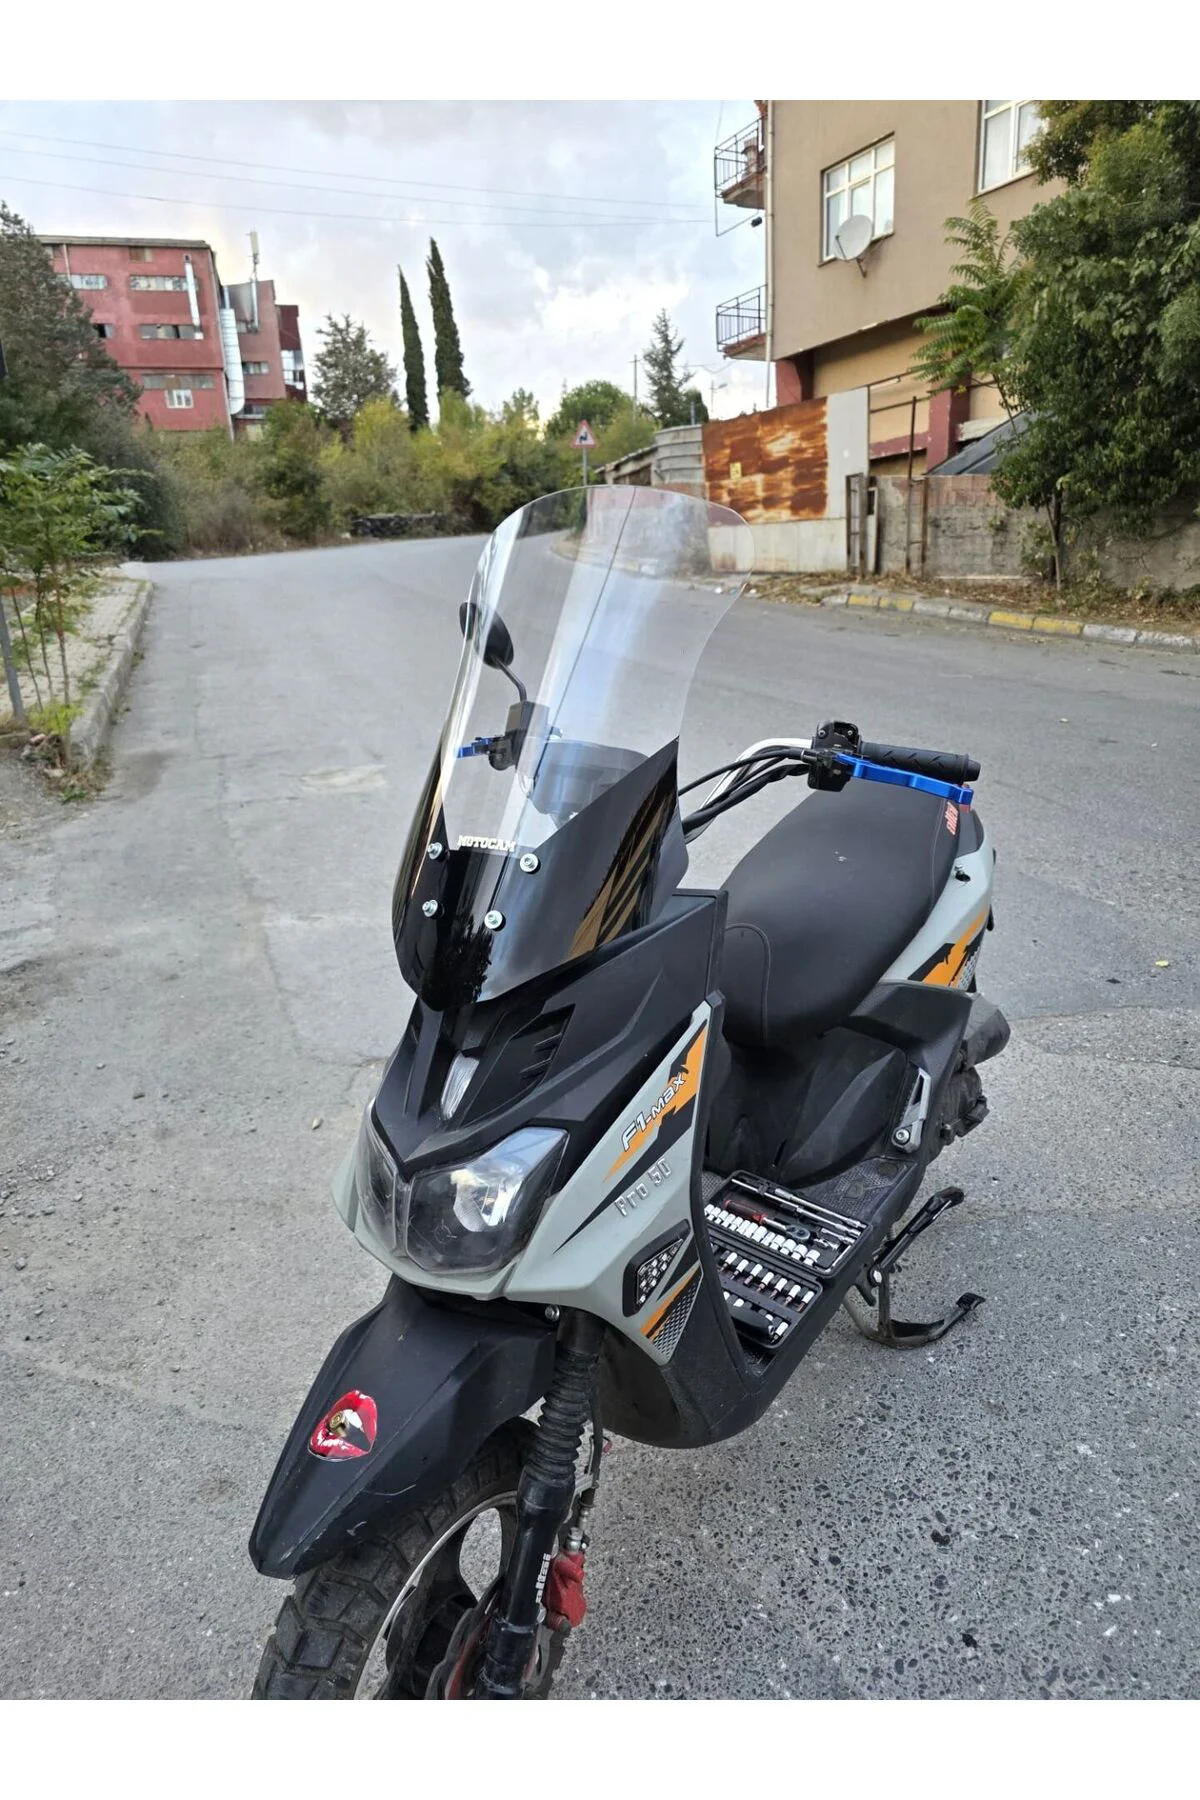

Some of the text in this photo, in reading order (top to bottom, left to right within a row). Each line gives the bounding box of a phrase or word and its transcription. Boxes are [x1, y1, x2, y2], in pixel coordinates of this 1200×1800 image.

[457, 835, 517, 853] MOTOCAM
[614, 1157, 672, 1217] Pro 50
